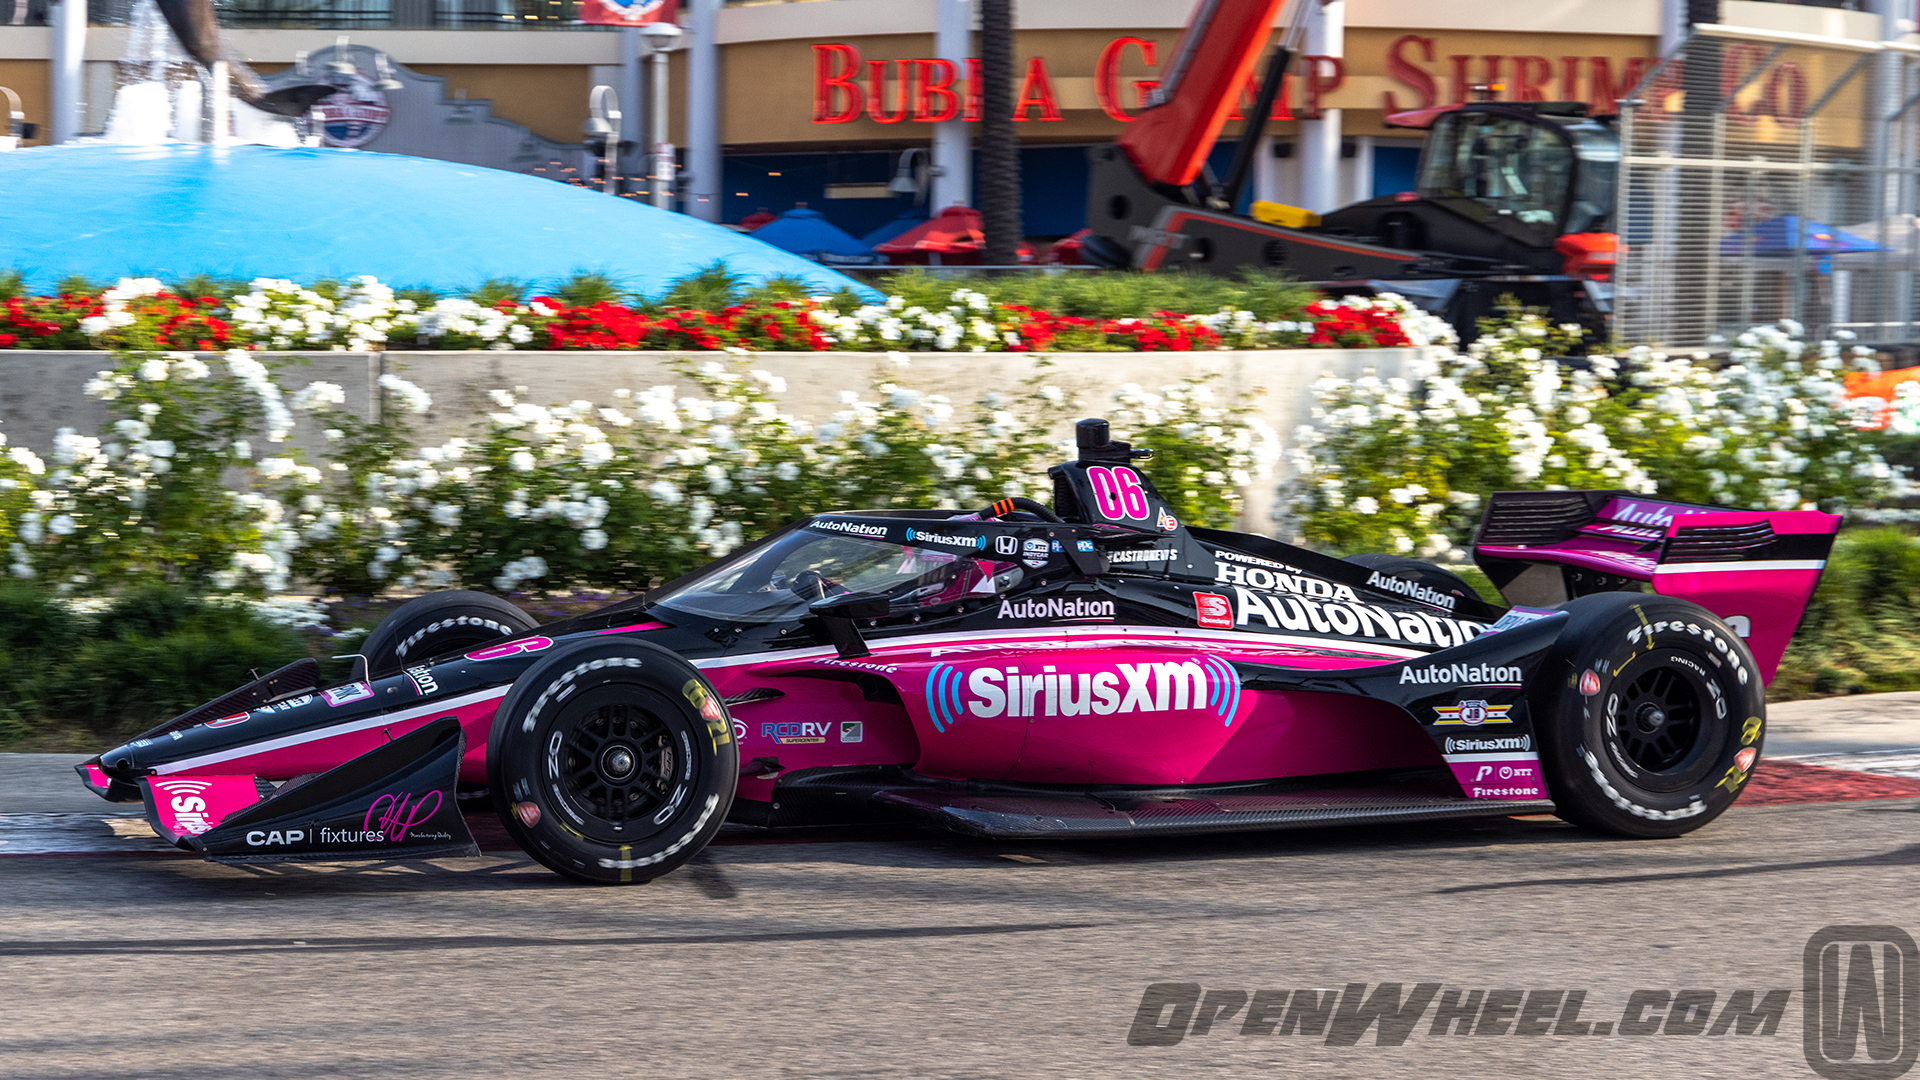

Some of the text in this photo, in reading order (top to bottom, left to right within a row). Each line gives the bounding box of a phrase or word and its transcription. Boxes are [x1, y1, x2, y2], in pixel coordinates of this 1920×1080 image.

[1086, 466, 1150, 520] 06
[810, 520, 888, 536] AutoNation
[1215, 550, 1285, 569] POWERED
[1214, 561, 1365, 604] HONDA
[1366, 571, 1456, 609] AutoNation
[998, 599, 1115, 619] AutoNation
[1399, 663, 1523, 684] AutoNation
[1513, 768, 1533, 776] NTT
[1472, 787, 1539, 798] Firestone
[246, 826, 385, 846] CAP fixtures
